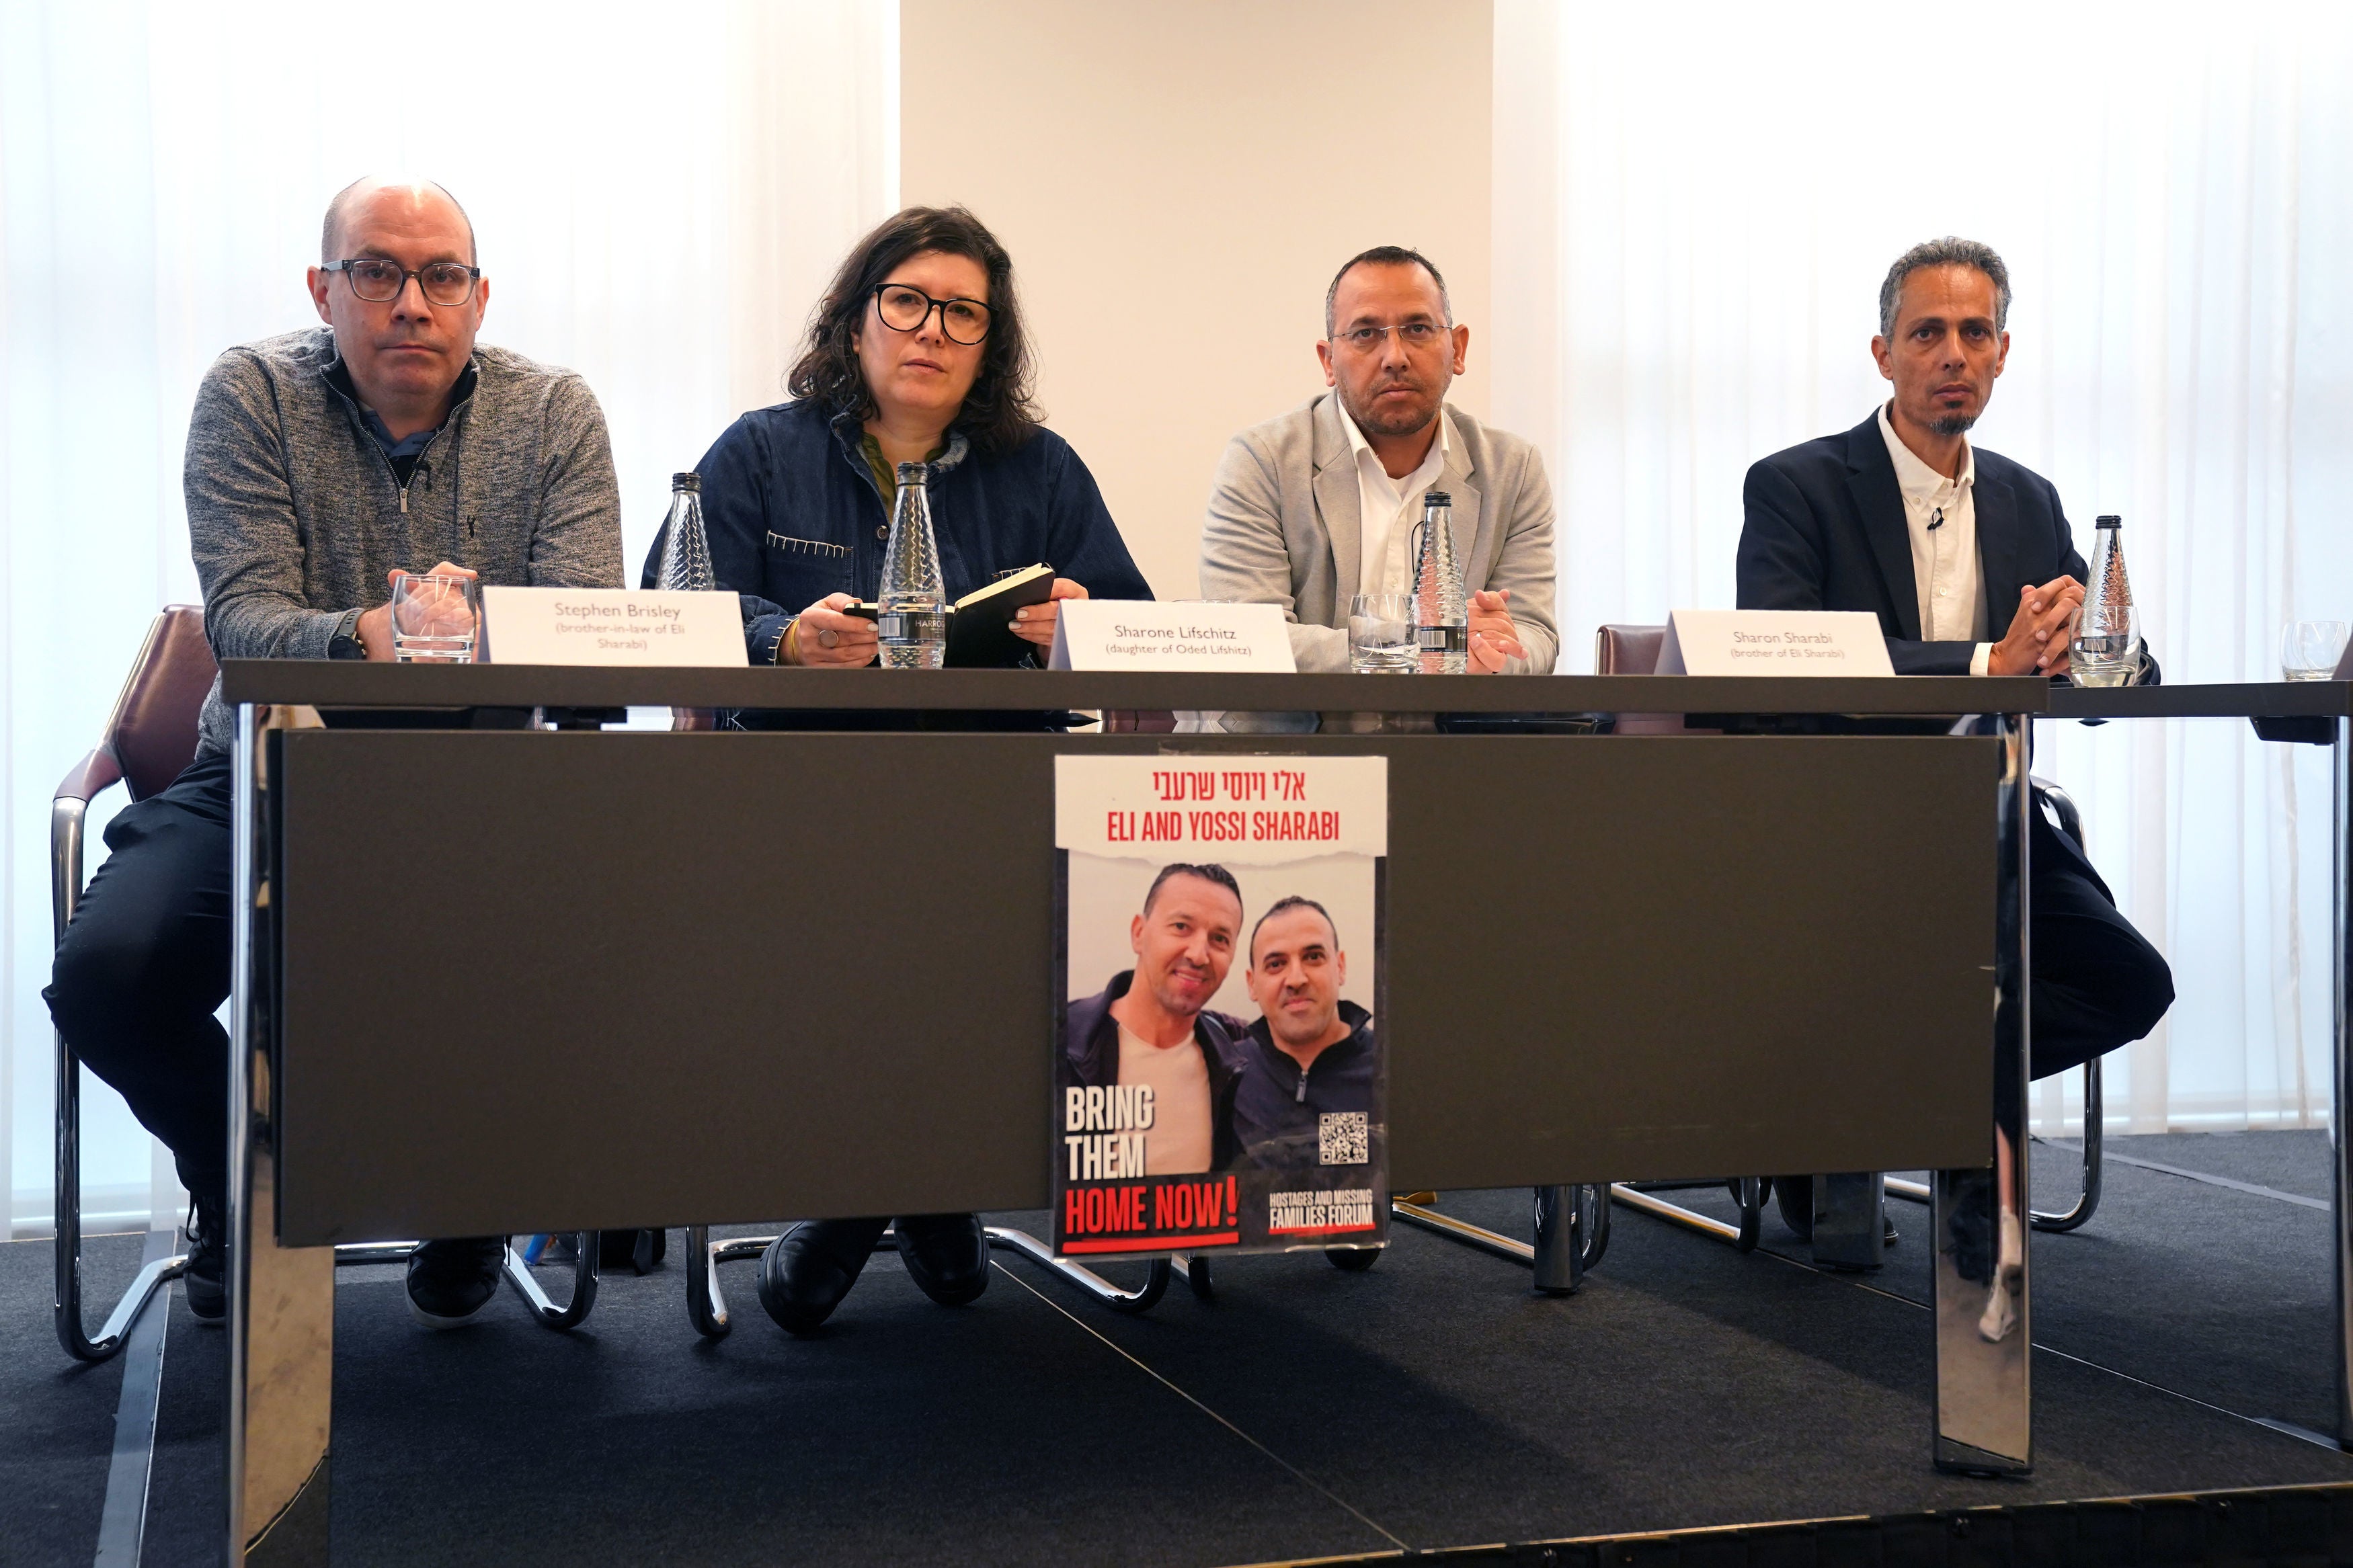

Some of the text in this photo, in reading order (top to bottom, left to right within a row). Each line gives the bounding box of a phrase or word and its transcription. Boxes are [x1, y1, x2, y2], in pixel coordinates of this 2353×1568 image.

[555, 603, 680, 621] Stephen Brisley
[556, 622, 685, 634] (brother-in-law of Eli
[1115, 625, 1237, 640] Sharone Lifschitz
[1733, 631, 1833, 644] Sharon Sharabi
[598, 638, 647, 651] Sharabi)
[1106, 643, 1252, 657] (daughter of Oded Lifshitz)
[1730, 649, 1845, 659] (brother of Eli Sharabi)
[1152, 770, 1306, 801] אלי ויוסי שרעבי
[1107, 811, 1339, 841] ELI AND YOSSI SHARABI
[1066, 1083, 1154, 1132] BRING
[1064, 1133, 1144, 1181] THEM
[1066, 1175, 1238, 1234] HOME NOW!
[1269, 1188, 1373, 1208] HOSTAGES AND MISSING
[1269, 1204, 1373, 1230] FAMILIES FORUM
